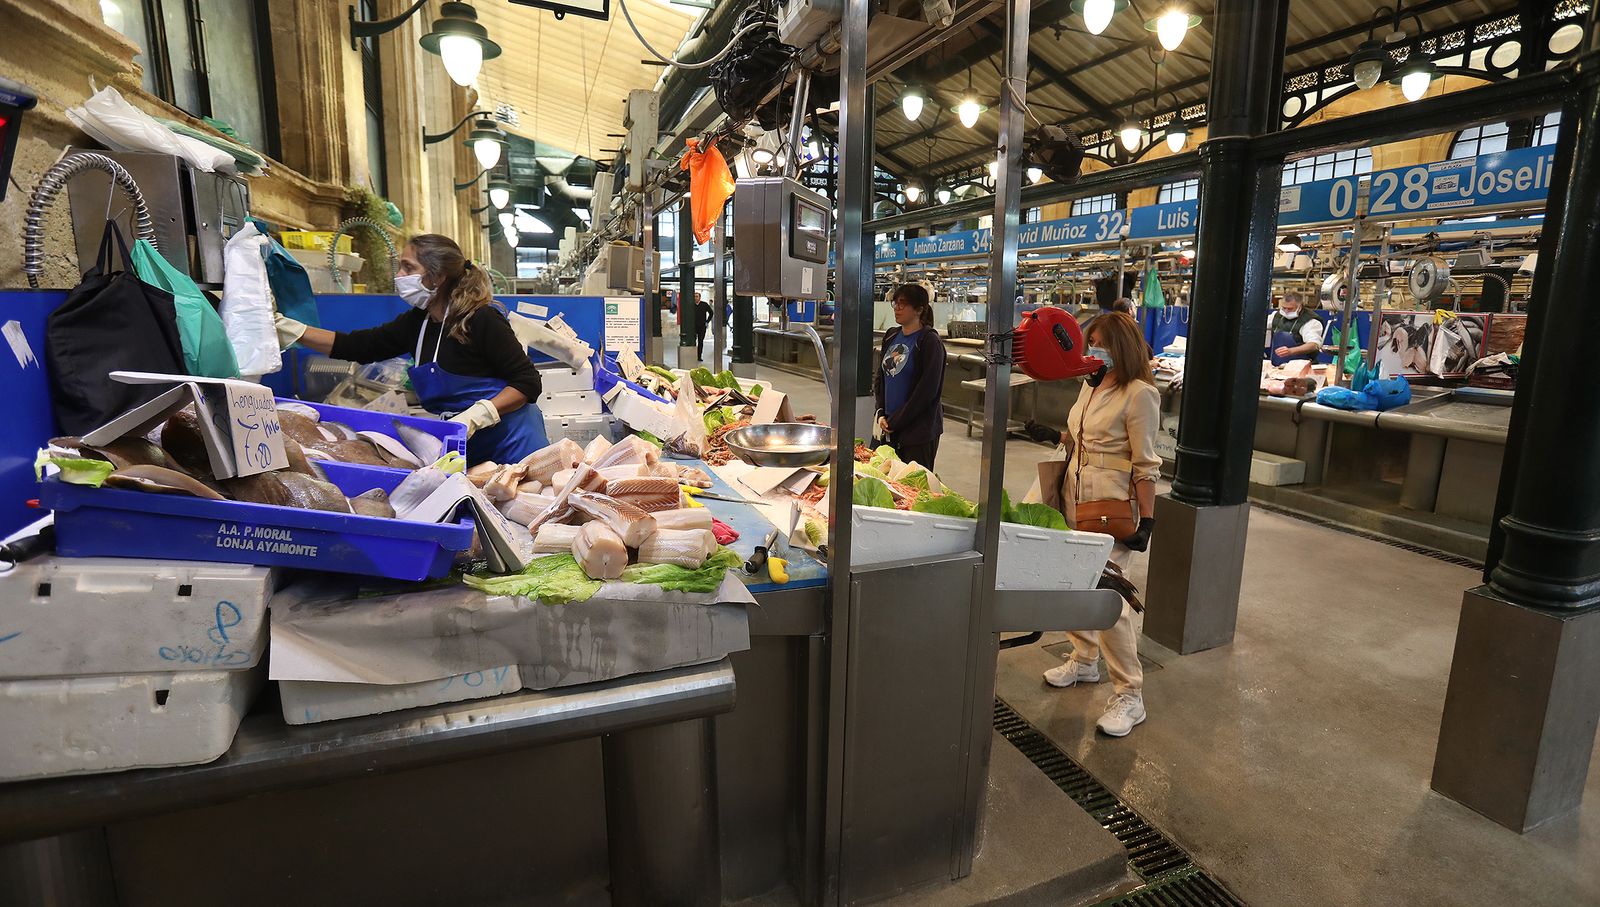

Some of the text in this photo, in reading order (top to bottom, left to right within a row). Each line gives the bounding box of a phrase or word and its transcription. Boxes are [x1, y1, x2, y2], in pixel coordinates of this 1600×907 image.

[1370, 167, 1429, 213] 28
[1041, 222, 1087, 242] Muñoz
[1095, 212, 1123, 241] 32
[1158, 207, 1190, 230] Luis
[913, 230, 989, 255] Antonio Zarzana 34
[218, 523, 293, 541] A.A. P.MORAL
[216, 537, 318, 557] LONJA AYAMONTE
